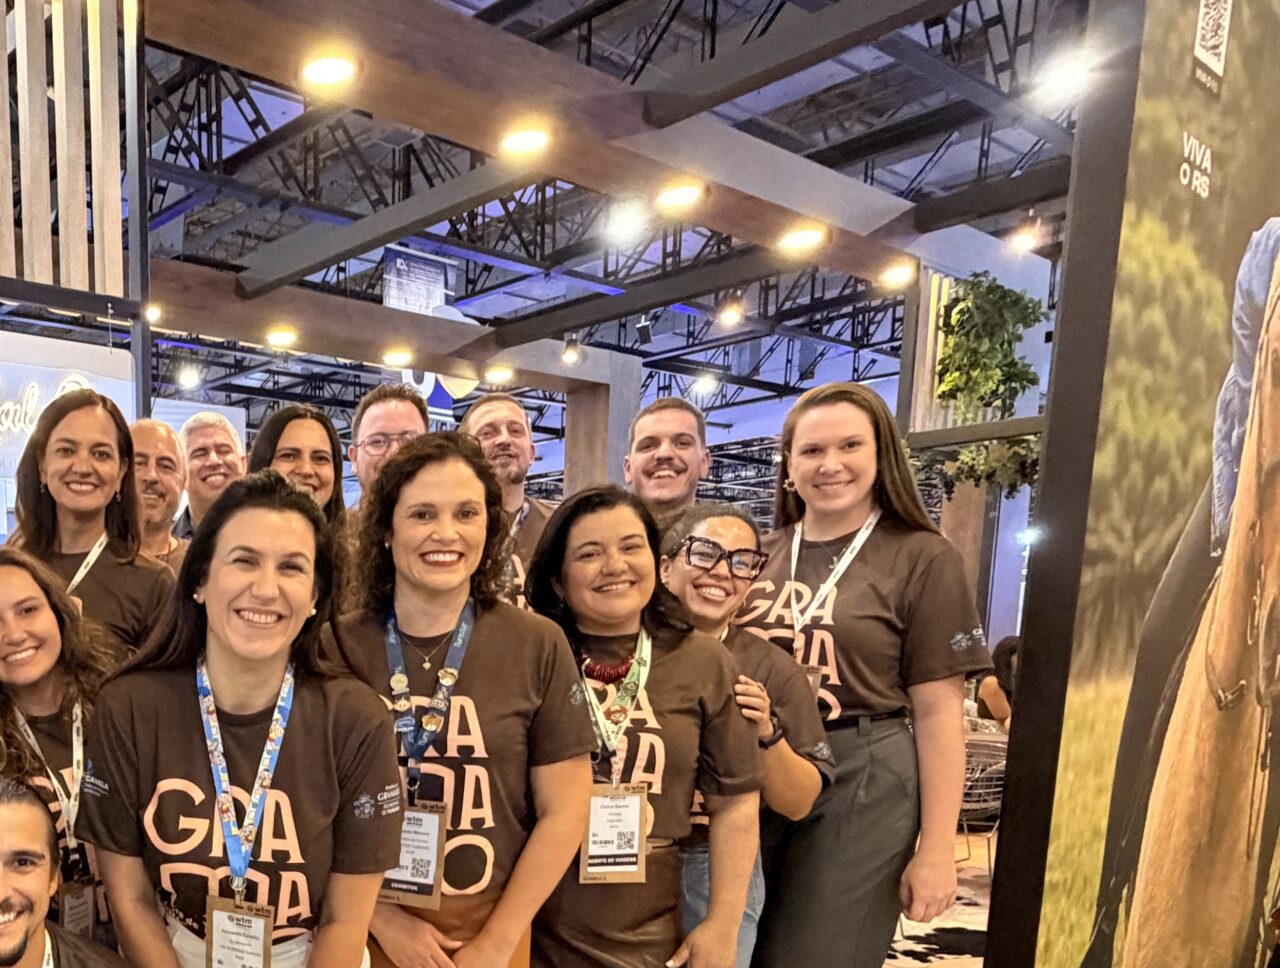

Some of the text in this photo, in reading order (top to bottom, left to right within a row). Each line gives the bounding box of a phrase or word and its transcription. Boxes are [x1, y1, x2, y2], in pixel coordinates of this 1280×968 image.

[1183, 131, 1212, 173] VIVA
[1180, 162, 1210, 198] O RS
[235, 916, 252, 925] wtm
[254, 906, 271, 914] wtm
